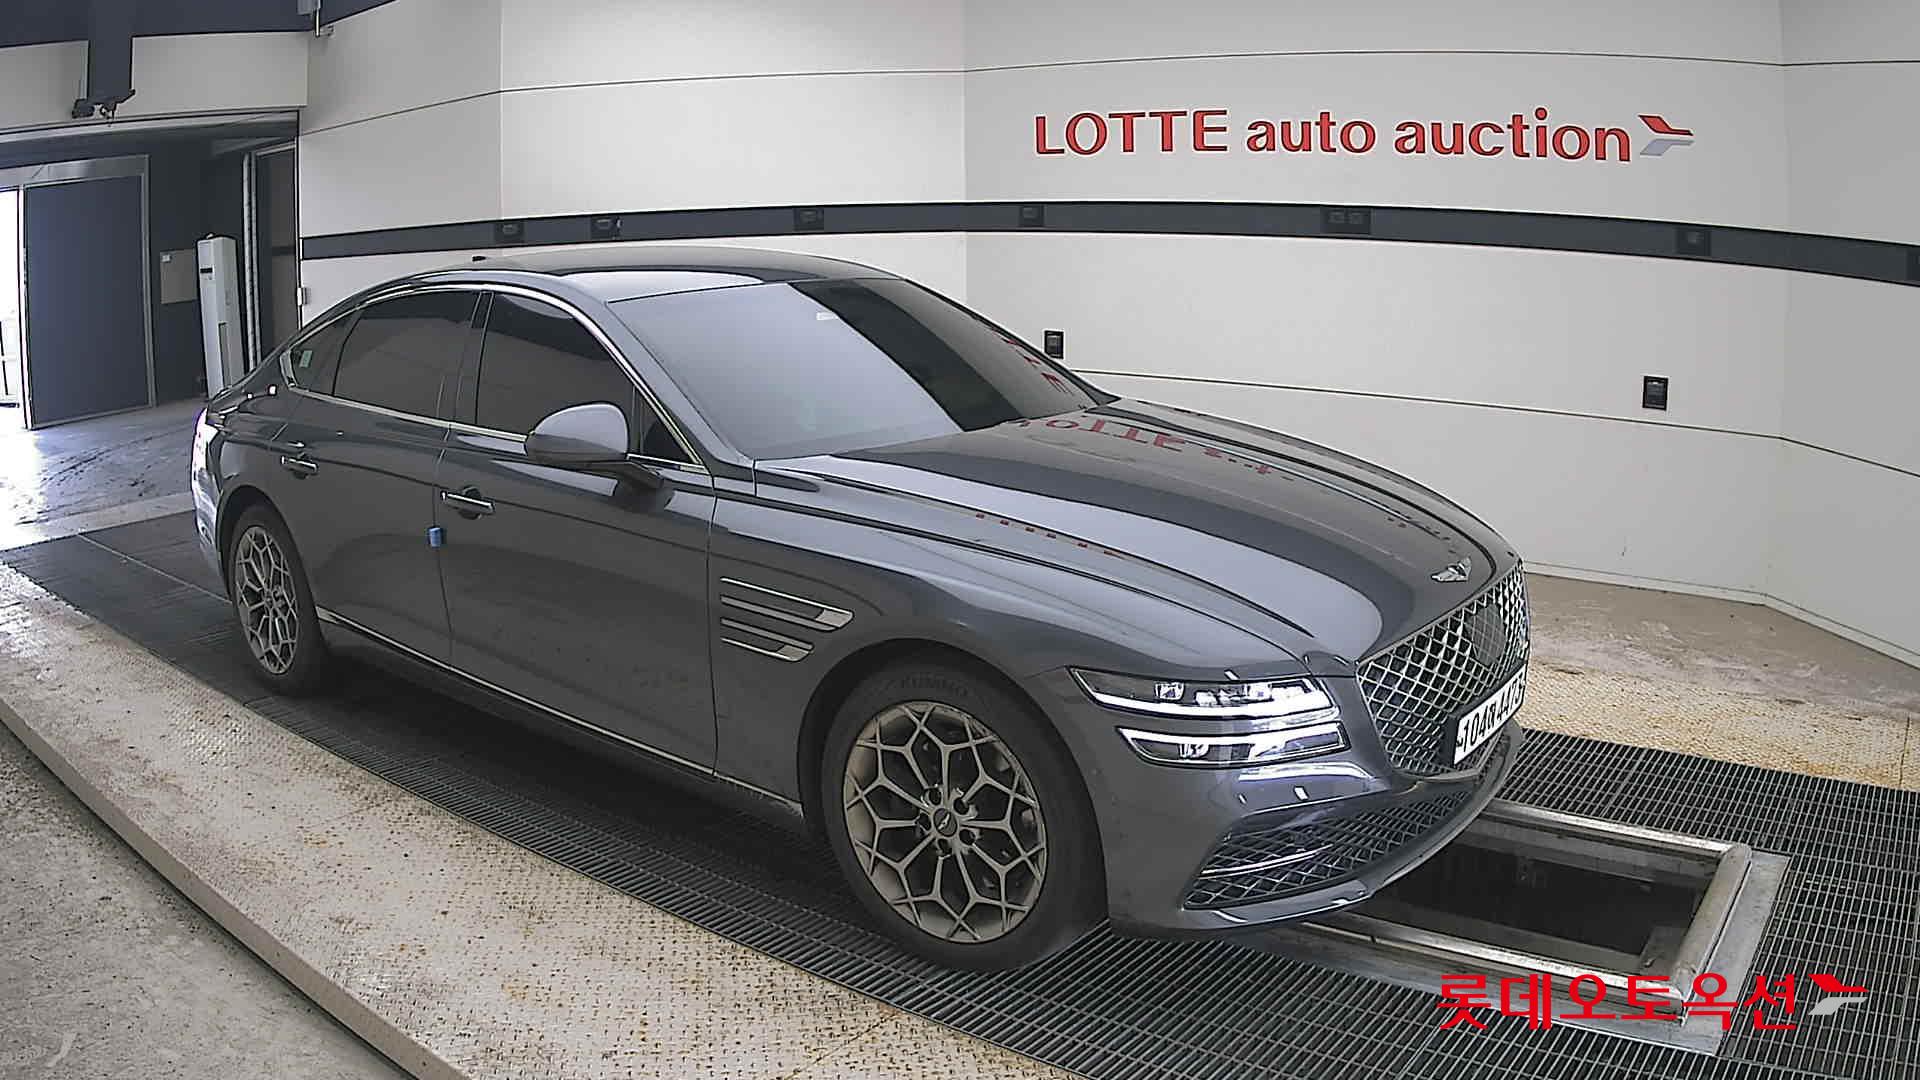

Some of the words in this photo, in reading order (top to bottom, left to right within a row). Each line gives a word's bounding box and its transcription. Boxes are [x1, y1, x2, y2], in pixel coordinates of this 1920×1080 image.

[1034, 109, 1228, 157] LOTTE
[1246, 110, 1377, 155] auto
[1393, 106, 1632, 163] auction
